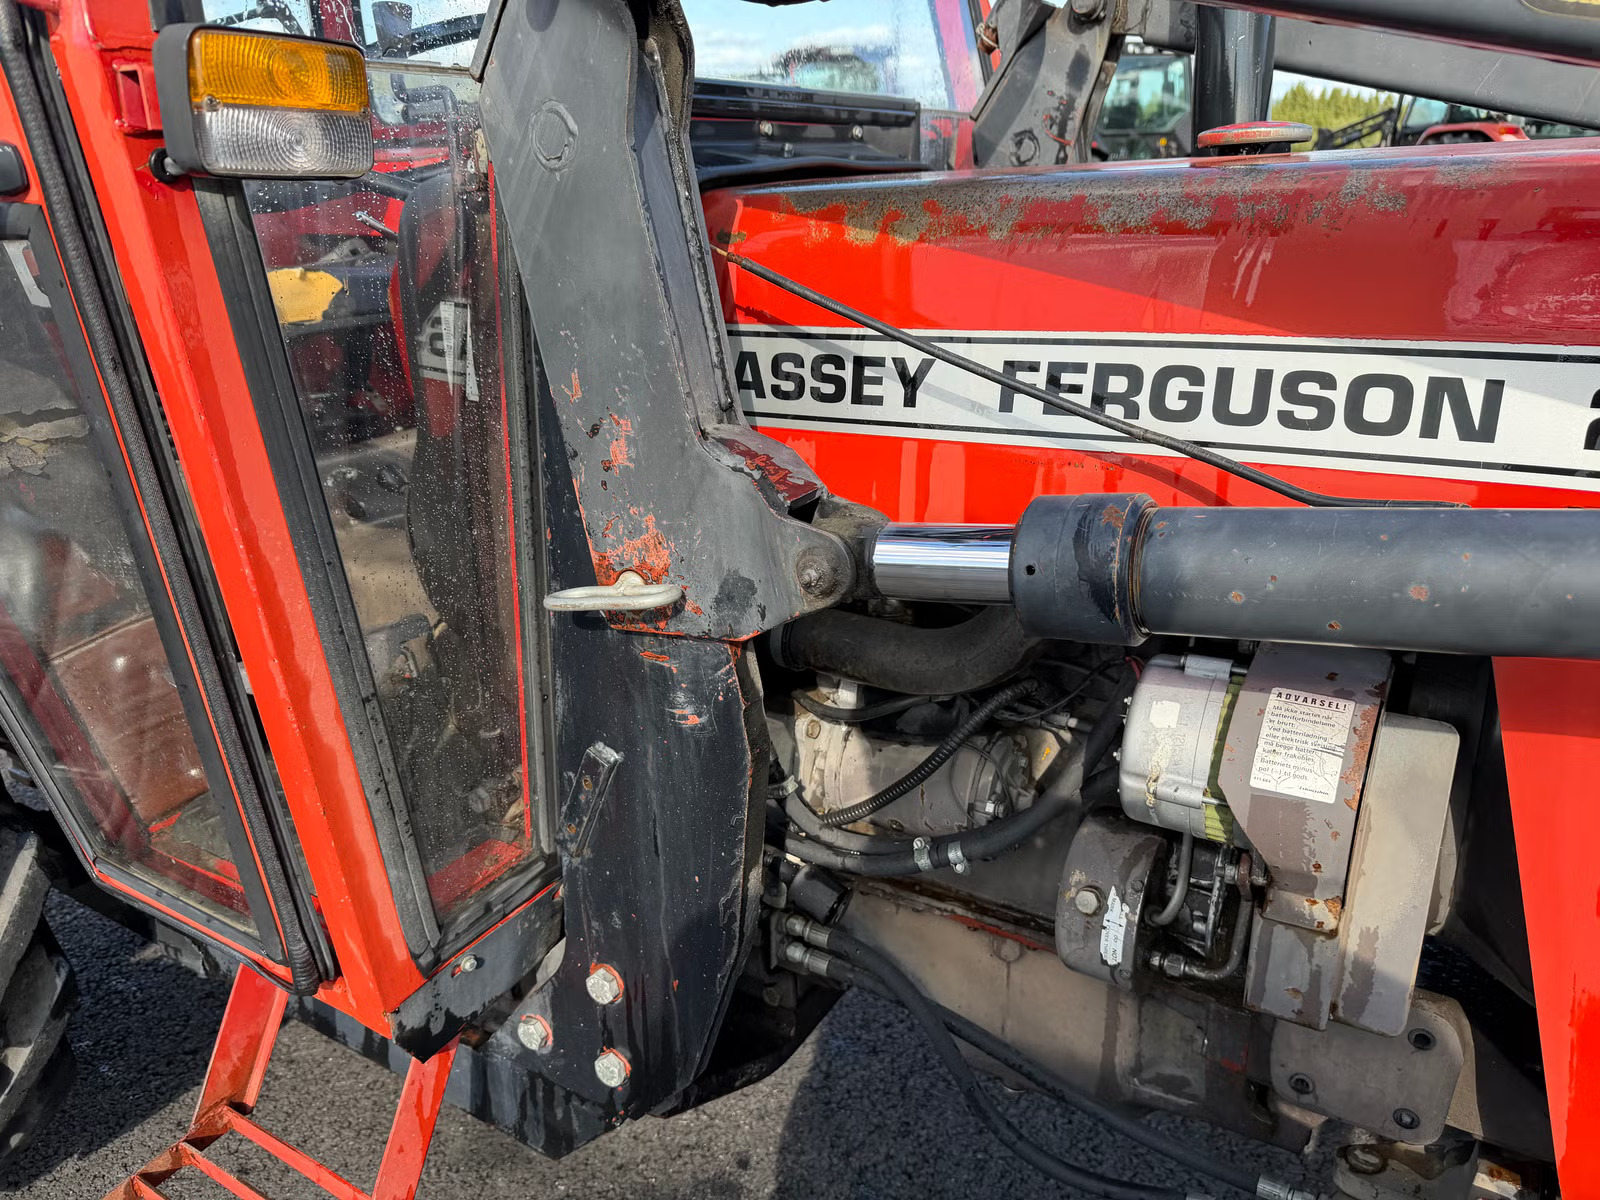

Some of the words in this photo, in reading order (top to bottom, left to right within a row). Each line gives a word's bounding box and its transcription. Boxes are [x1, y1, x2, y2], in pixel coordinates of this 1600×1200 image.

[735, 351, 936, 408] ASSEY
[998, 359, 1505, 444] FERGUSON
[1276, 691, 1347, 711] ADVARSEL!
